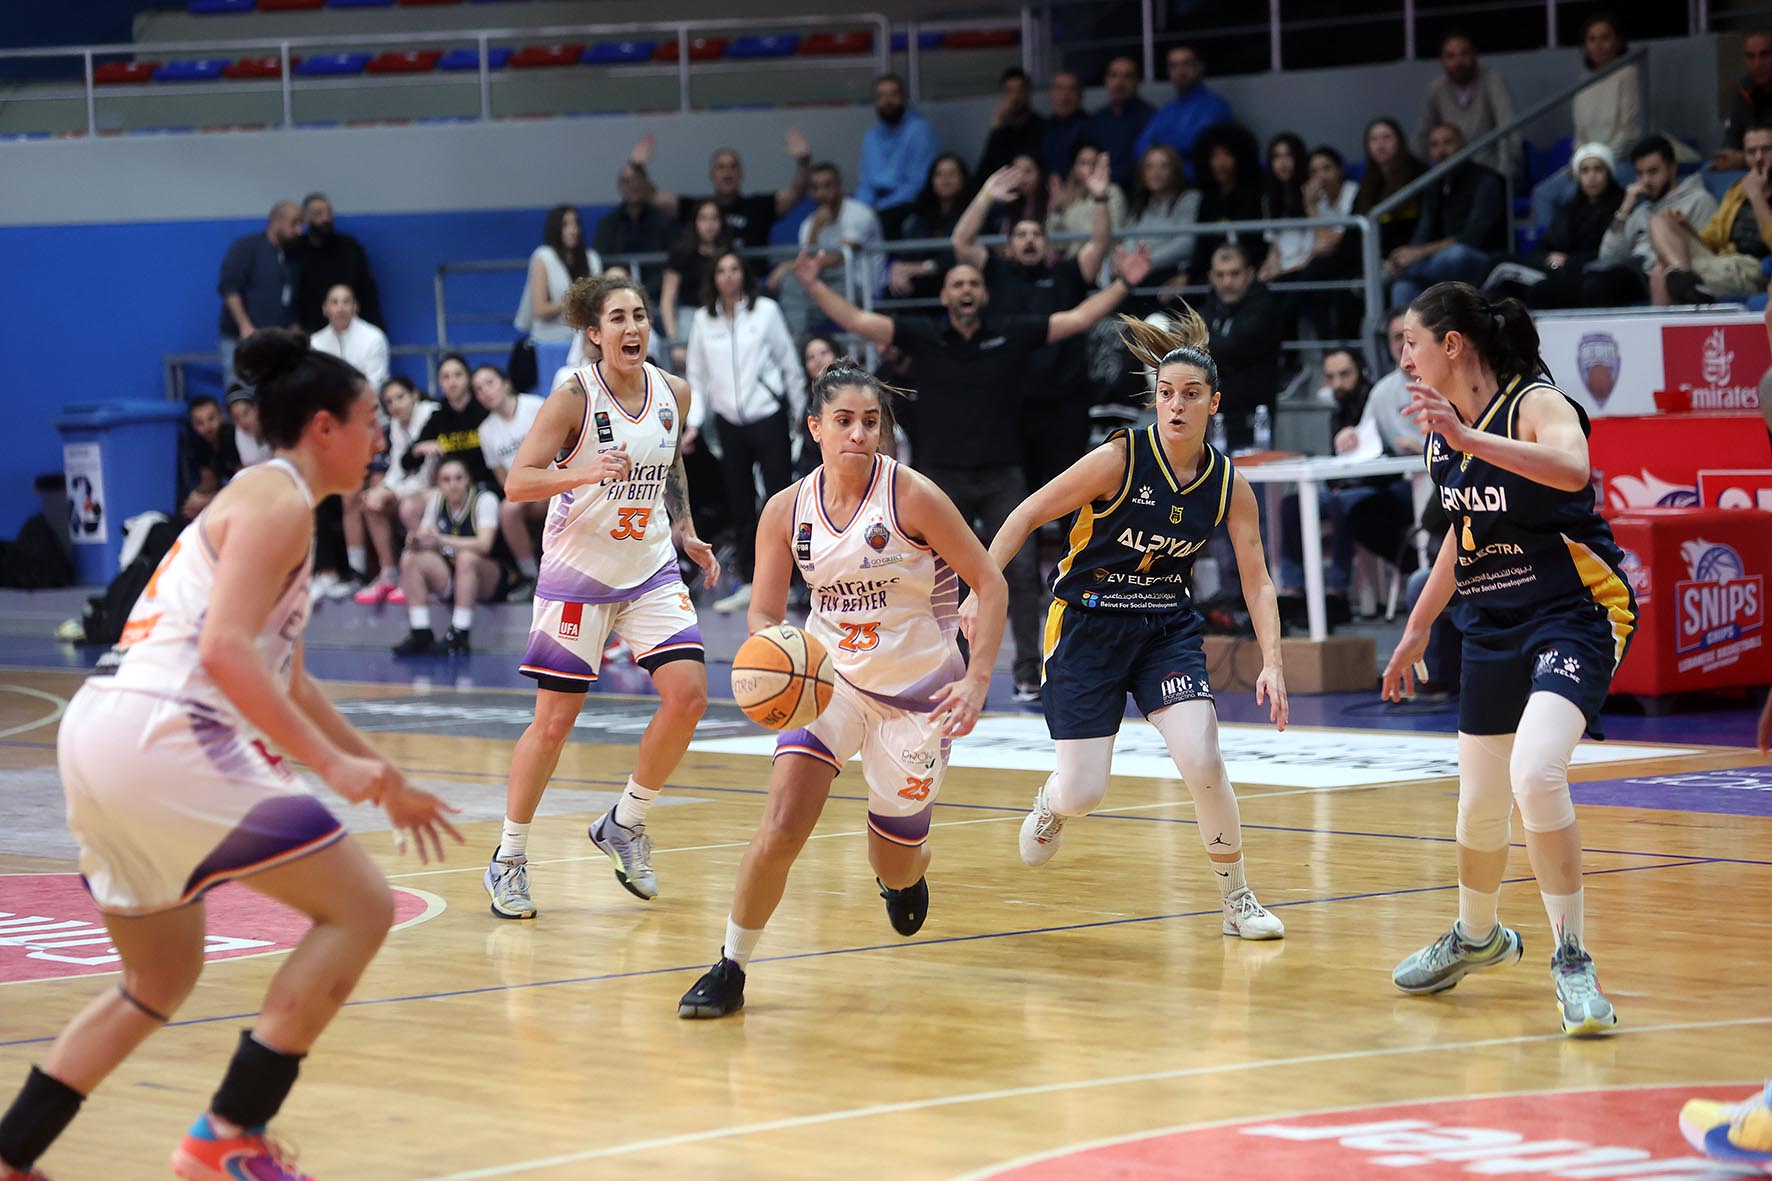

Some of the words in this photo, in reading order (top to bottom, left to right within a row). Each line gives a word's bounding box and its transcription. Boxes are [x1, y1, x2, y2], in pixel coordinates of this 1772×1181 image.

[1132, 497, 1155, 506] KELME
[610, 507, 652, 540] 33
[1107, 573, 1126, 583] EV
[820, 595, 840, 612] FLY
[842, 590, 888, 612] BETTER
[560, 621, 579, 635] UFA
[839, 621, 880, 652] 23
[1161, 675, 1193, 696] ARC
[897, 776, 934, 801] 23
